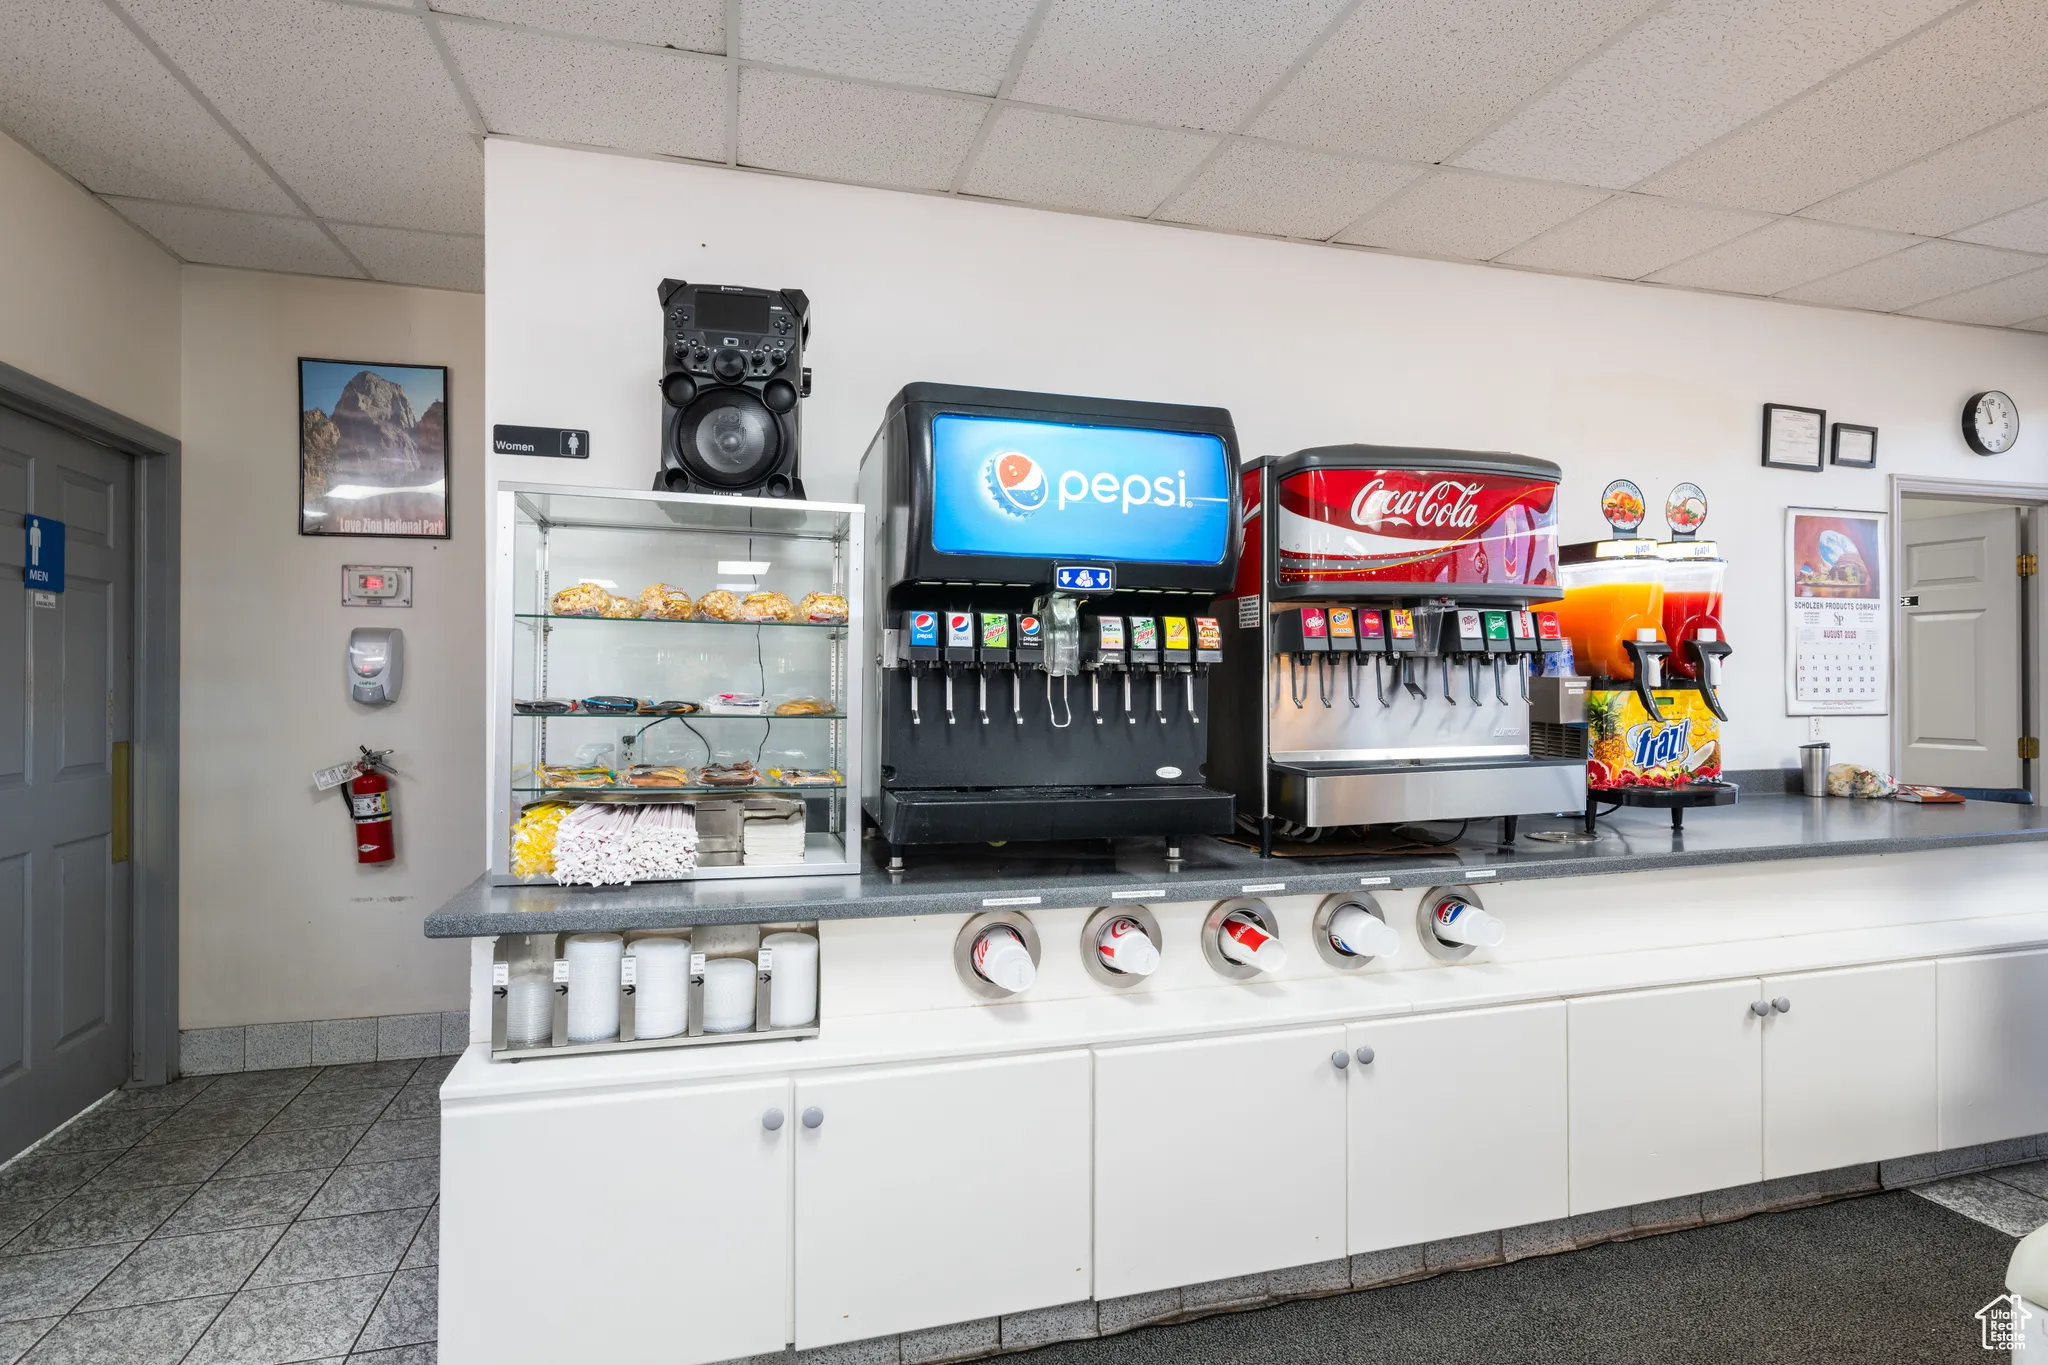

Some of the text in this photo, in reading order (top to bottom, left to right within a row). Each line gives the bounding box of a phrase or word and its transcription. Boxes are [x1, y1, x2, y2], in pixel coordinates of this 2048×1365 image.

[496, 440, 535, 452] Women
[1058, 469, 1190, 514] pepsi
[1608, 481, 1638, 495] GEORGIA PEACH
[1350, 478, 1485, 528] Coca-Cola
[340, 517, 445, 535] Love Zion National Park
[29, 569, 49, 582] MEN
[1794, 601, 1881, 611] SCHOLZEN PRODUCTS COMPANY
[1823, 630, 1843, 639] AUGUST
[1844, 630, 1857, 639] 2025
[1634, 717, 1690, 768] frazil
